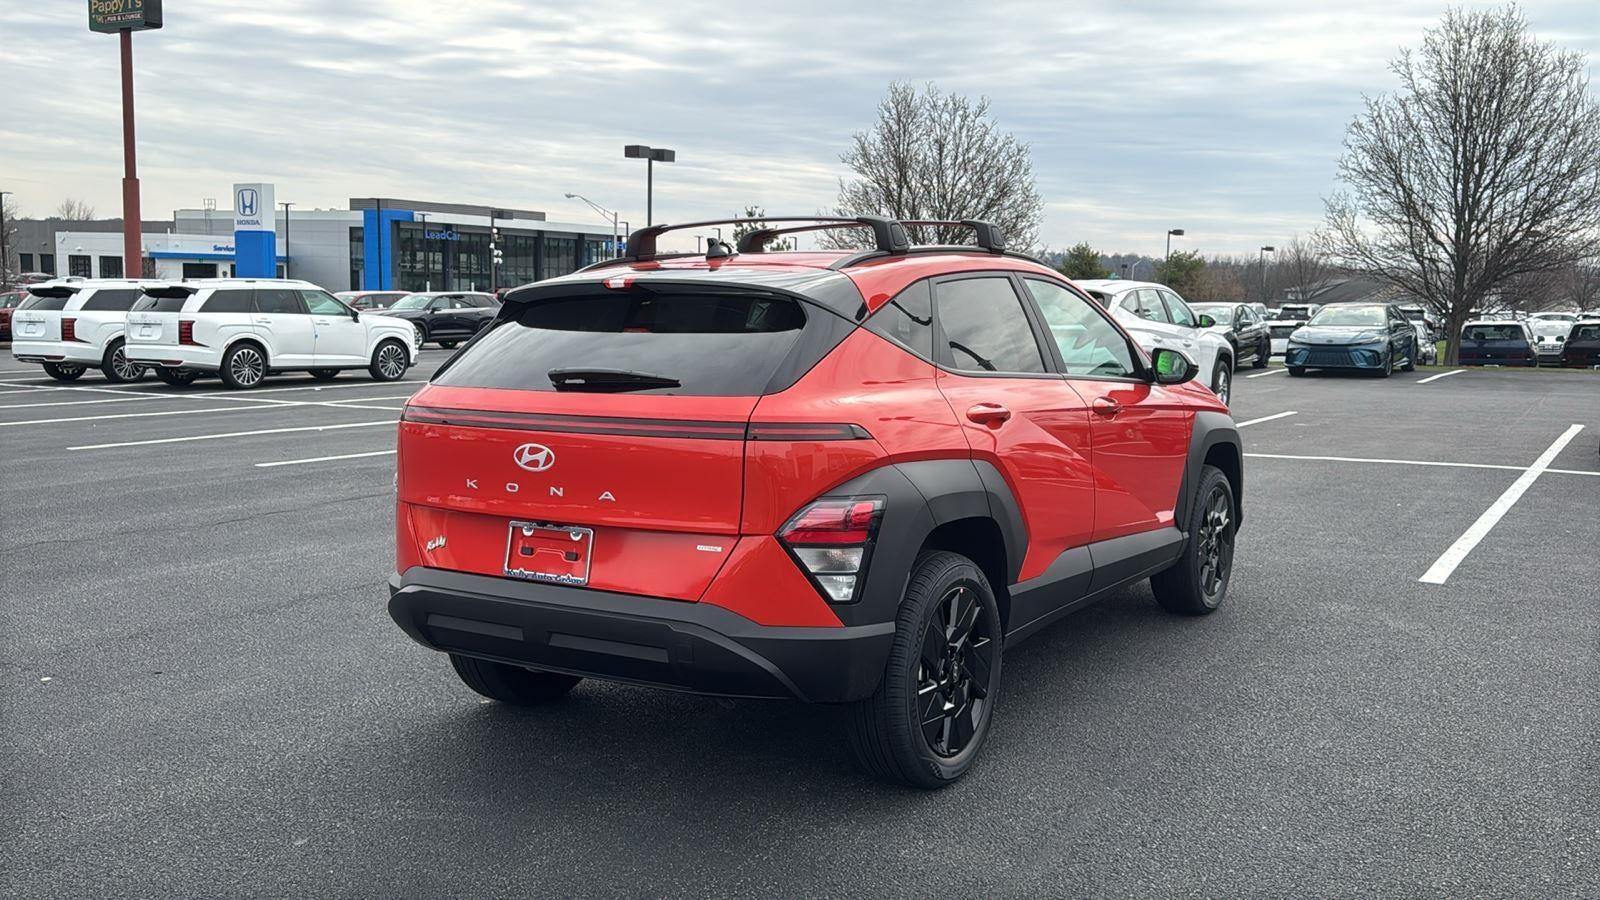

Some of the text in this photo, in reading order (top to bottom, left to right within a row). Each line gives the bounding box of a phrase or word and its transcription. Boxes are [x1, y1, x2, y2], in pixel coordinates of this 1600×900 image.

[91, 0, 125, 13] Pappy
[425, 229, 461, 240] LeadCar
[466, 478, 616, 502] KONA
[506, 569, 582, 584] Kelly Auto Group
